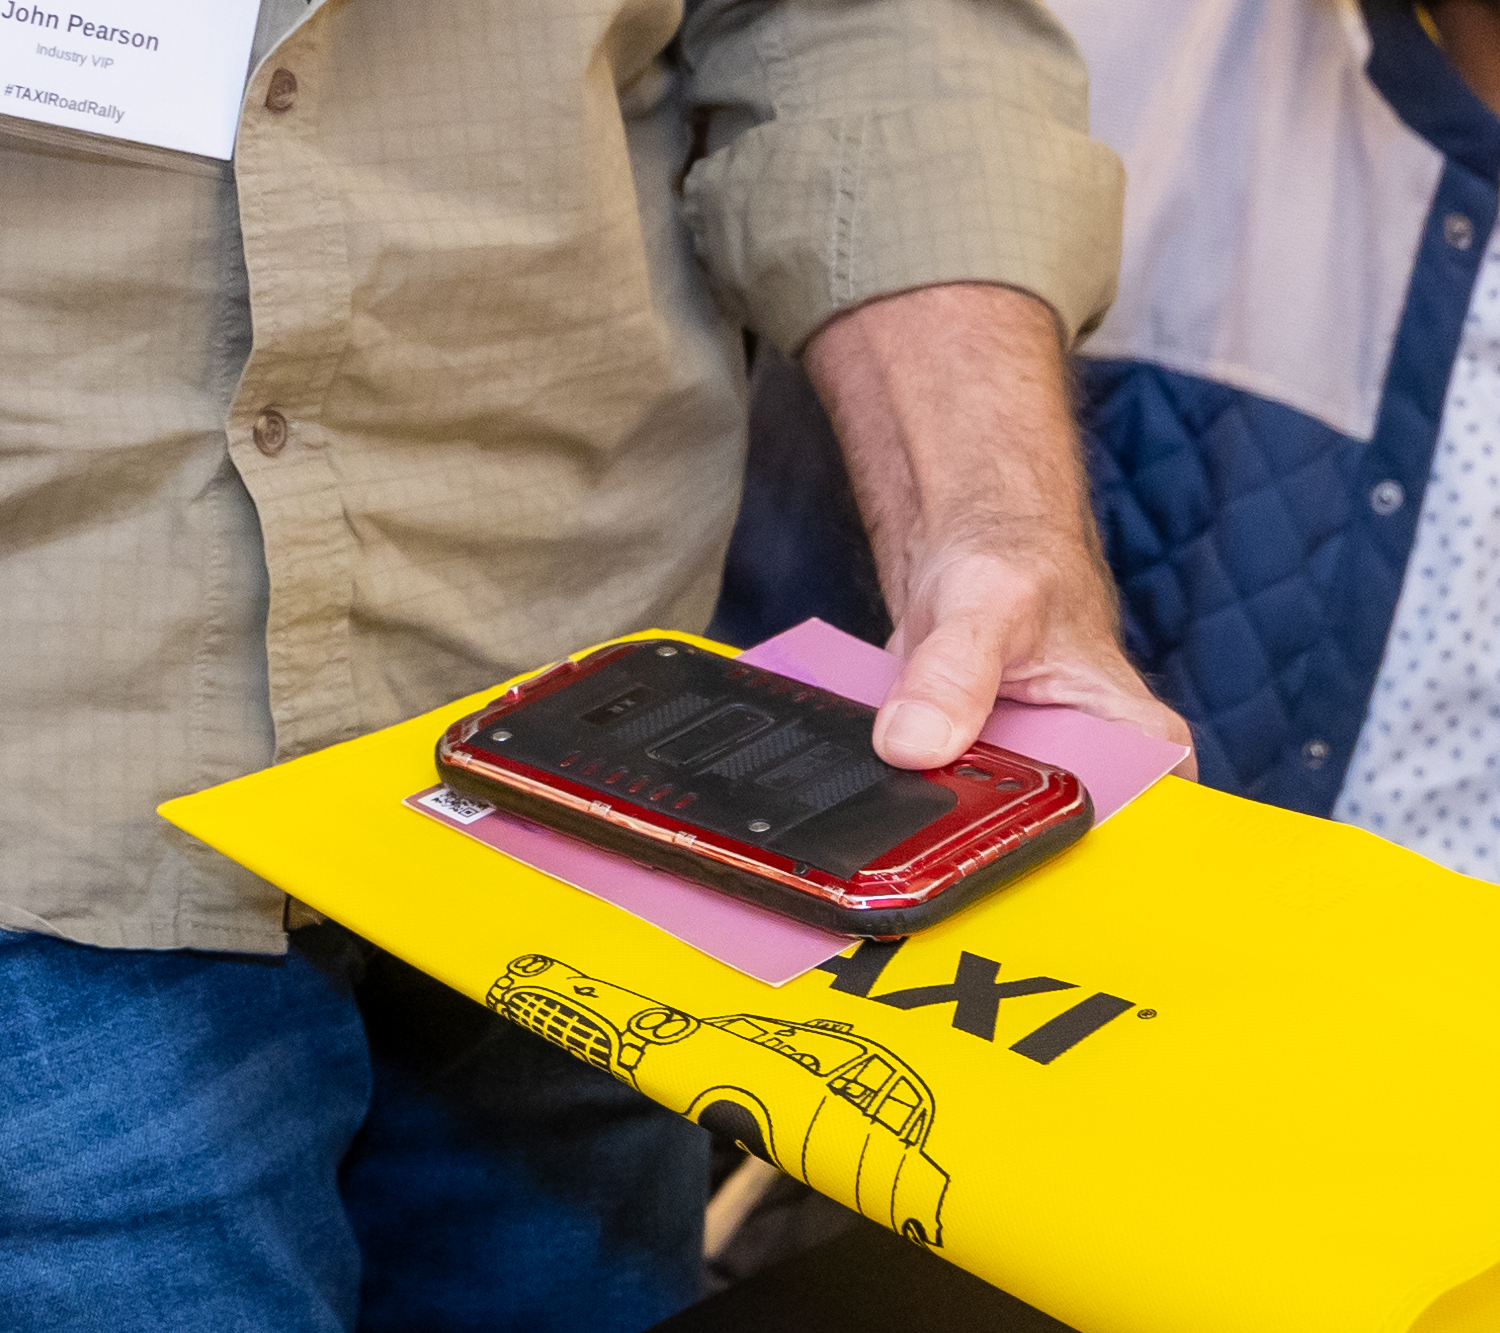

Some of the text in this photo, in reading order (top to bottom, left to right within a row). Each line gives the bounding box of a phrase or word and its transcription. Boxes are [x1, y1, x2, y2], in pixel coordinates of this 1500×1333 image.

[1, 0, 159, 52] John Pearson
[36, 42, 115, 70] Industry VIP
[4, 83, 126, 124] #TAXIRoadRally
[814, 936, 1137, 1066] AXI
